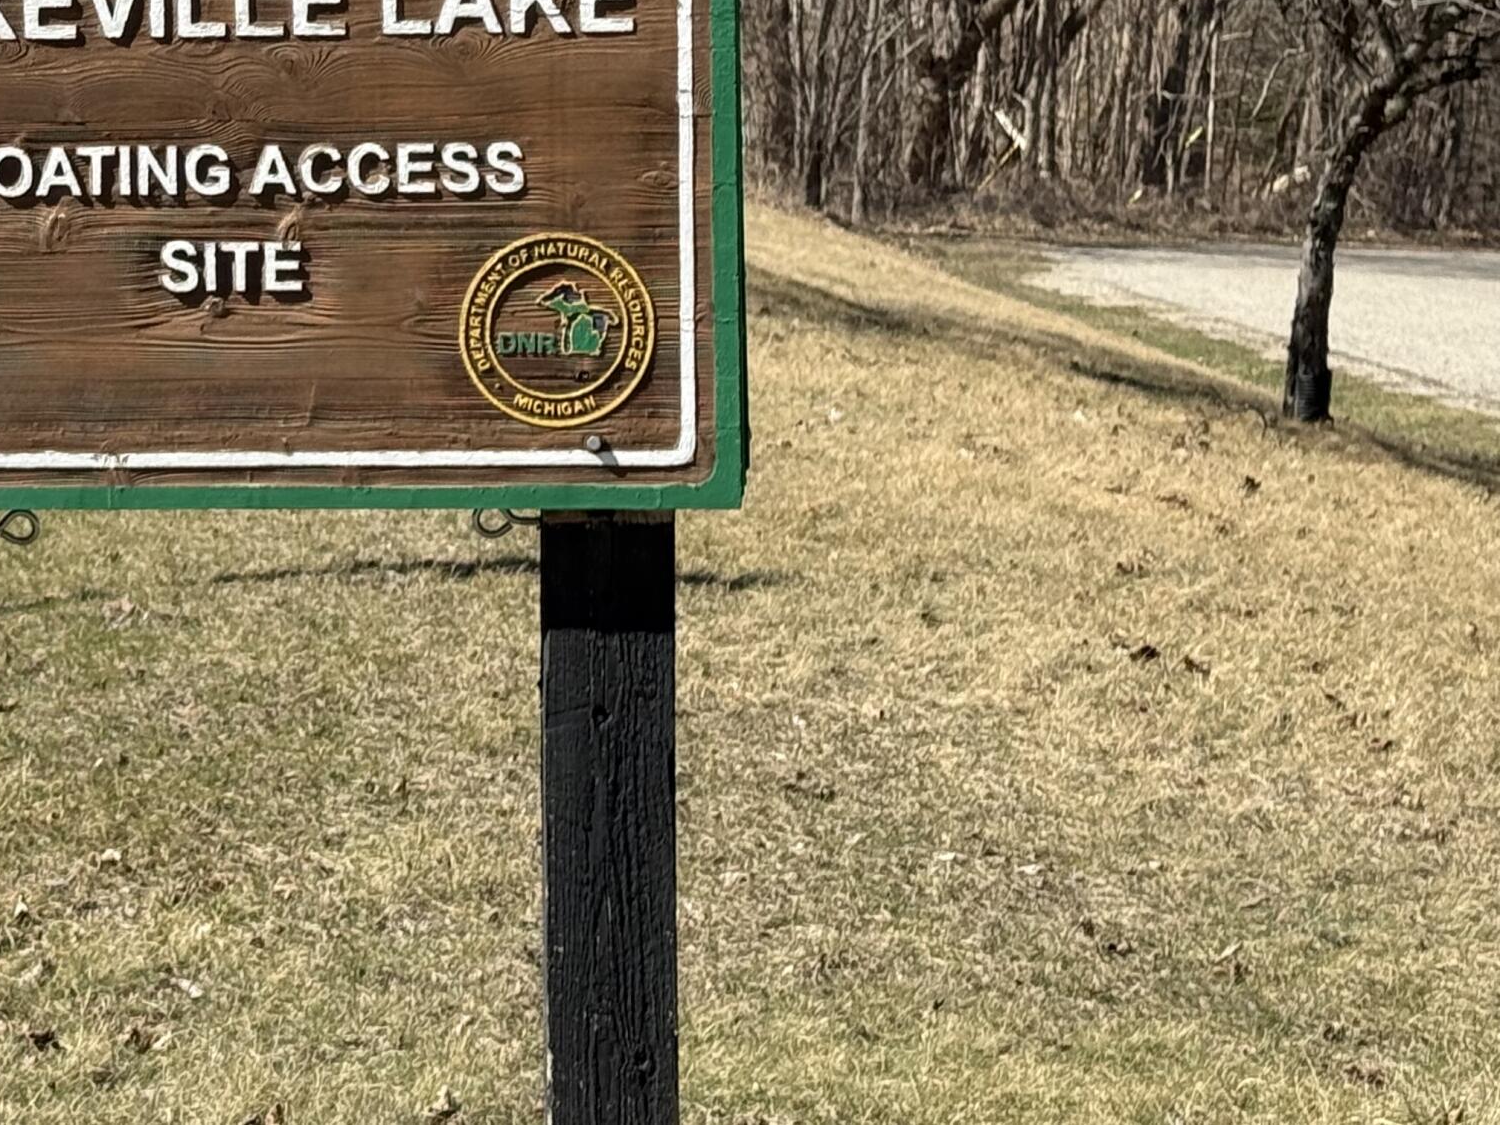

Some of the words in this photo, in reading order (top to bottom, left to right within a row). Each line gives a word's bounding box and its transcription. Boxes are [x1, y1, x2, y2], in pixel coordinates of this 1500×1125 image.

[249, 141, 526, 195] ACCESS
[160, 240, 303, 293] SITE
[469, 262, 507, 372] DEPARTMENT
[508, 248, 528, 267] OF
[534, 242, 608, 272] NATURAL
[610, 267, 645, 371] RESOURCES
[497, 331, 558, 356] DNR
[513, 392, 597, 417] MICHIGAN
